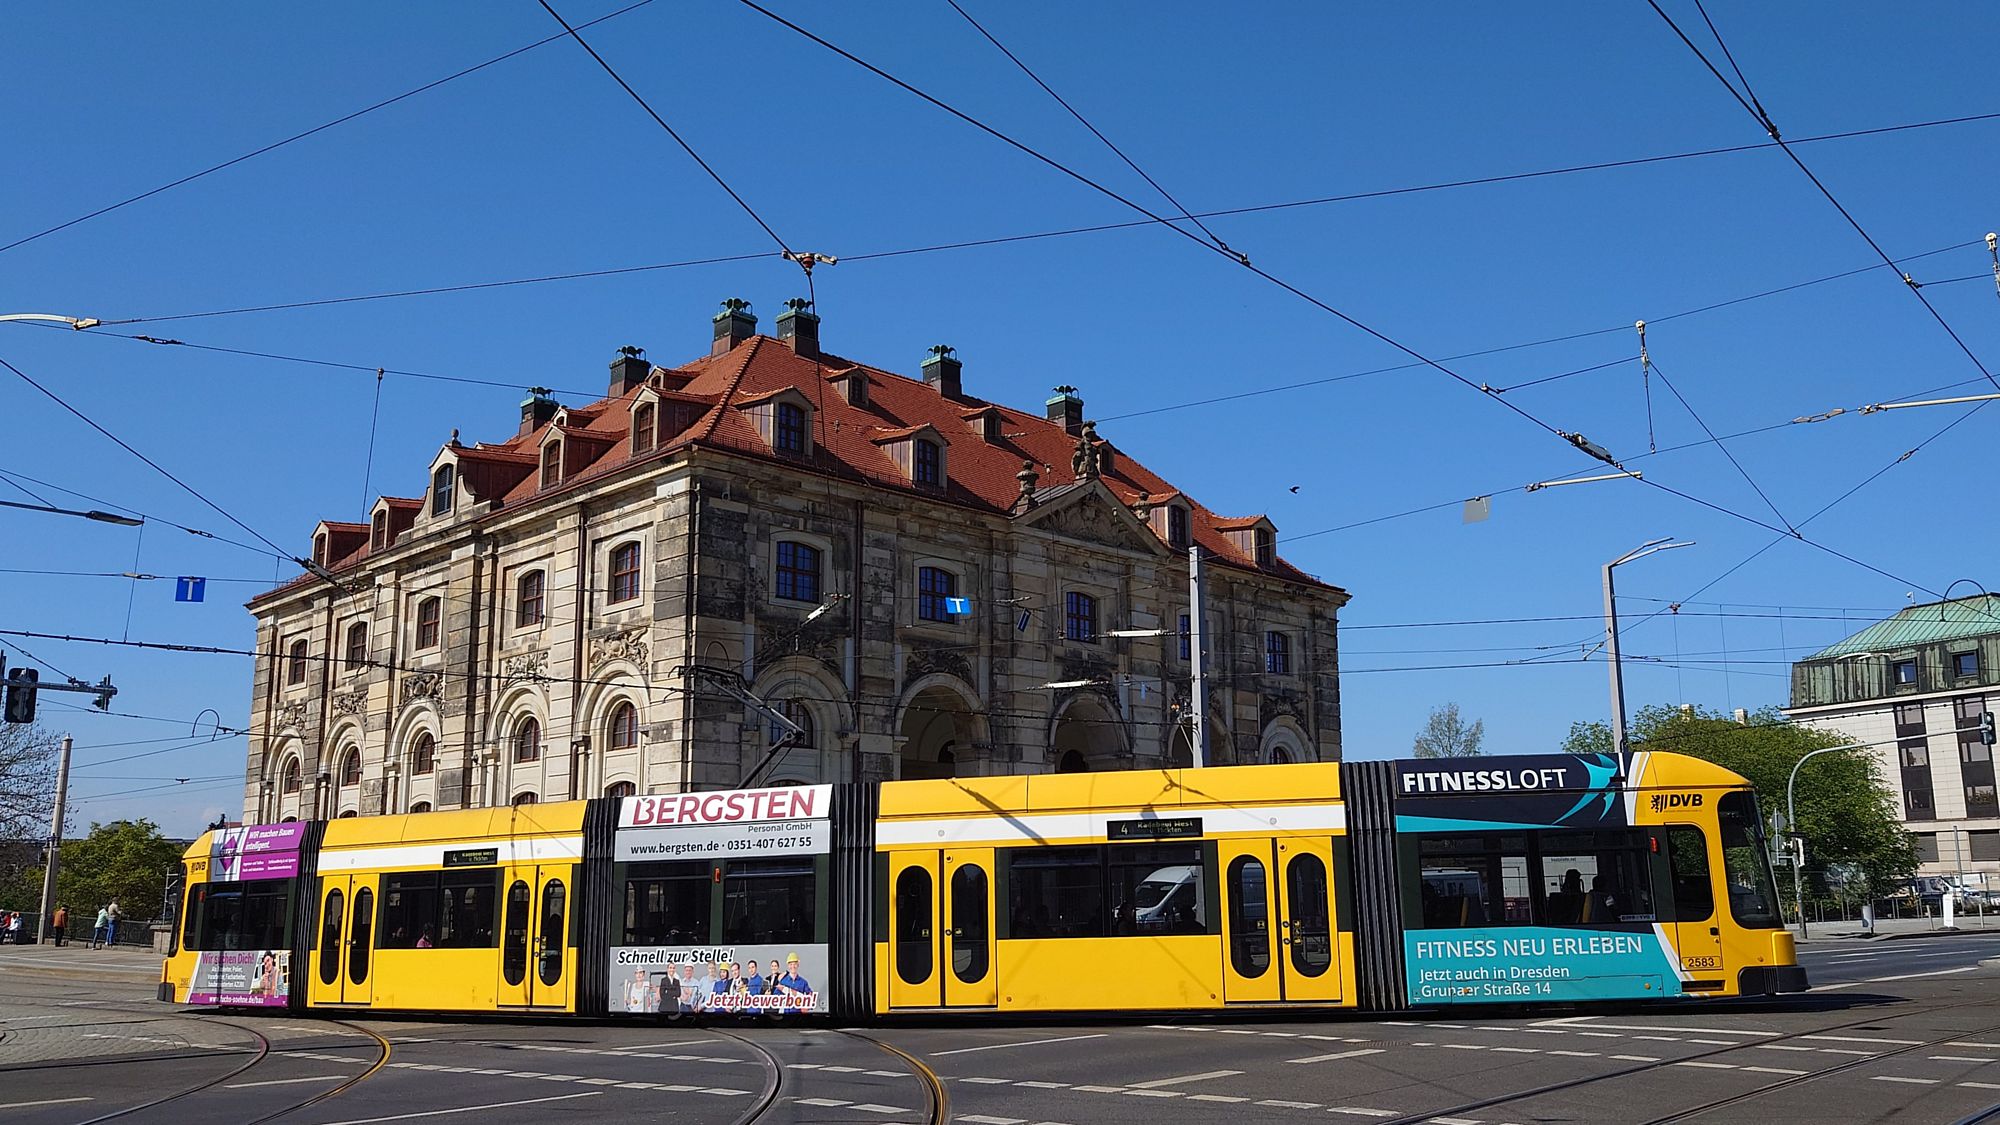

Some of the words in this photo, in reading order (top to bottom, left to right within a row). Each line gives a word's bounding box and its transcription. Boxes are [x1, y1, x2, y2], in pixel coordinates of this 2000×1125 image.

[183, 579, 200, 600] T
[949, 598, 965, 613] T
[1403, 769, 1567, 792] FITNESSLOFT
[632, 789, 815, 825] BERGSTEN
[1669, 794, 1703, 807] DVB
[249, 830, 259, 839] WIR
[260, 829, 278, 838] machen
[279, 828, 295, 837] Bauen
[748, 823, 784, 834] Personal
[786, 822, 812, 831] GmbH
[1121, 823, 1128, 834] 4
[631, 839, 719, 855] www.bergsten.de
[728, 838, 775, 851] 0351-407
[778, 837, 796, 849] 627
[799, 836, 812, 847] 55
[1416, 939, 1497, 959] FITNESS
[1503, 938, 1546, 956] NEU
[1553, 936, 1643, 955] ERLEBEN
[202, 953, 213, 964] Wir
[237, 952, 255, 964] Dich!
[618, 950, 665, 964] Schnell
[667, 953, 688, 963] zur
[690, 949, 734, 963] Stelle!
[1688, 957, 1715, 967] 2583
[1419, 968, 1451, 983] Jetzt
[1455, 967, 1489, 981] auch
[1493, 966, 1506, 980] in
[1510, 965, 1570, 979] Dresden
[1484, 982, 1530, 996] Straße
[1535, 982, 1552, 994] 14
[706, 993, 741, 1008] Jetzt
[743, 992, 817, 1007] bewerben!
